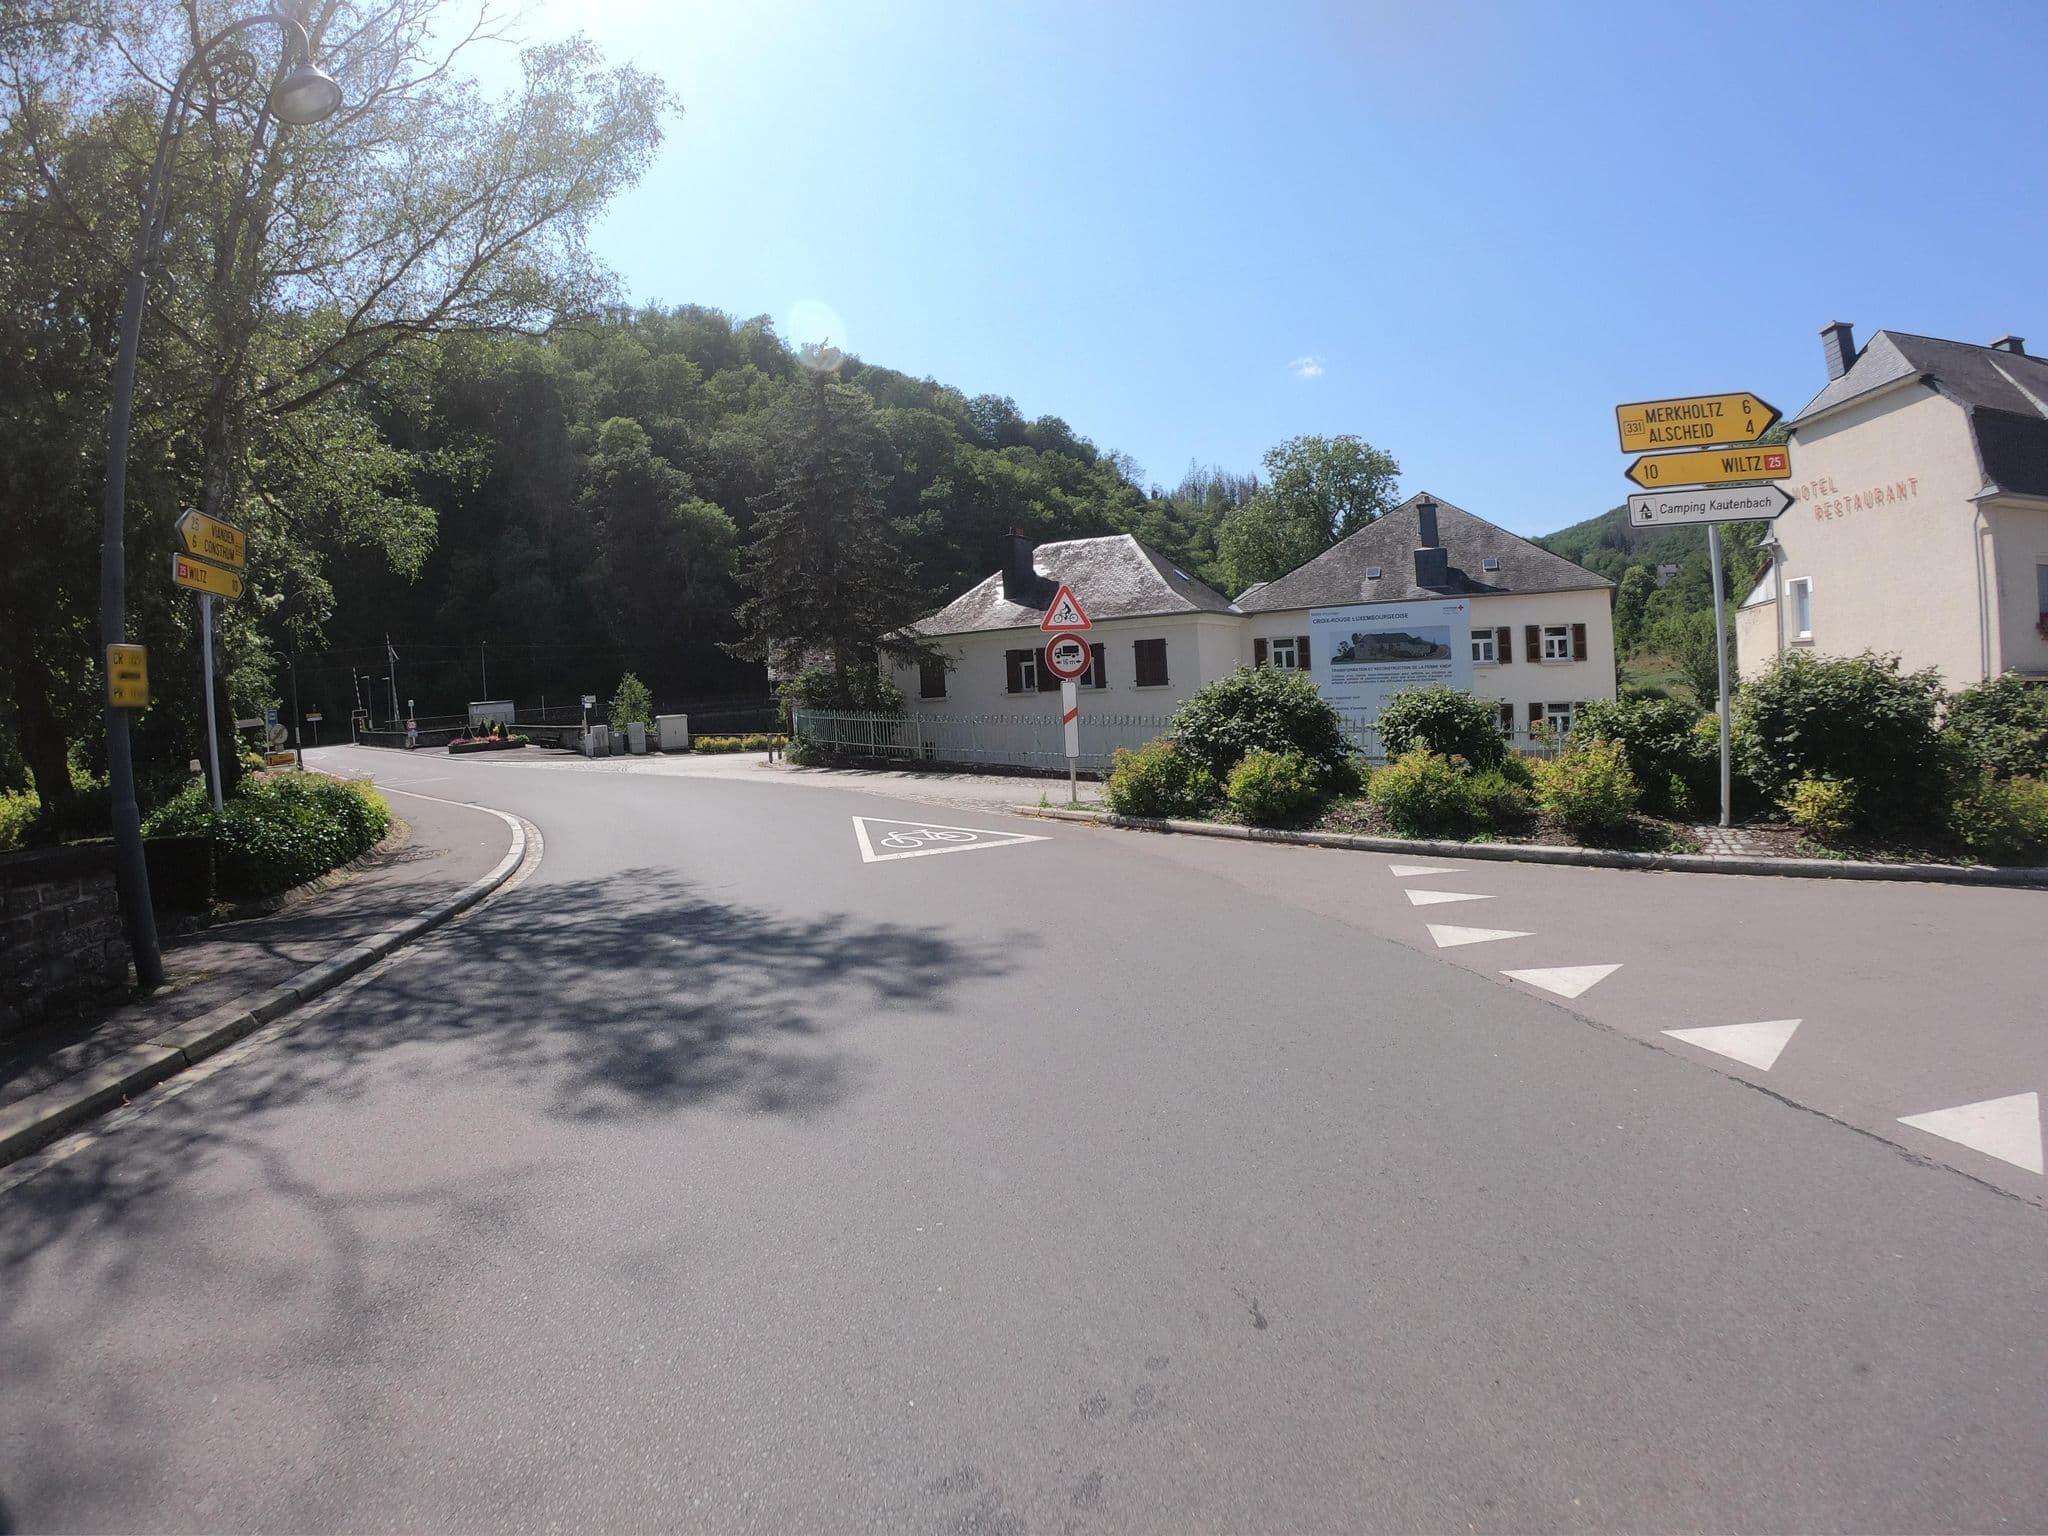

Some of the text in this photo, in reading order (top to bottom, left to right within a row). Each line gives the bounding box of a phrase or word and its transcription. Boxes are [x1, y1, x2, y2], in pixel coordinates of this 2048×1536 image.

[1645, 400, 1752, 424] MERKHOLTZ 6
[1626, 422, 1643, 434] 331
[1649, 419, 1754, 443] ALSCHEID 4
[1644, 455, 1782, 480] 10 WILTZ 25
[1792, 476, 1839, 502] HOTEL
[1814, 477, 1918, 522] RESTAURANT
[1659, 496, 1772, 516] Camping Kautenbach
[188, 565, 208, 584] WILTZ
